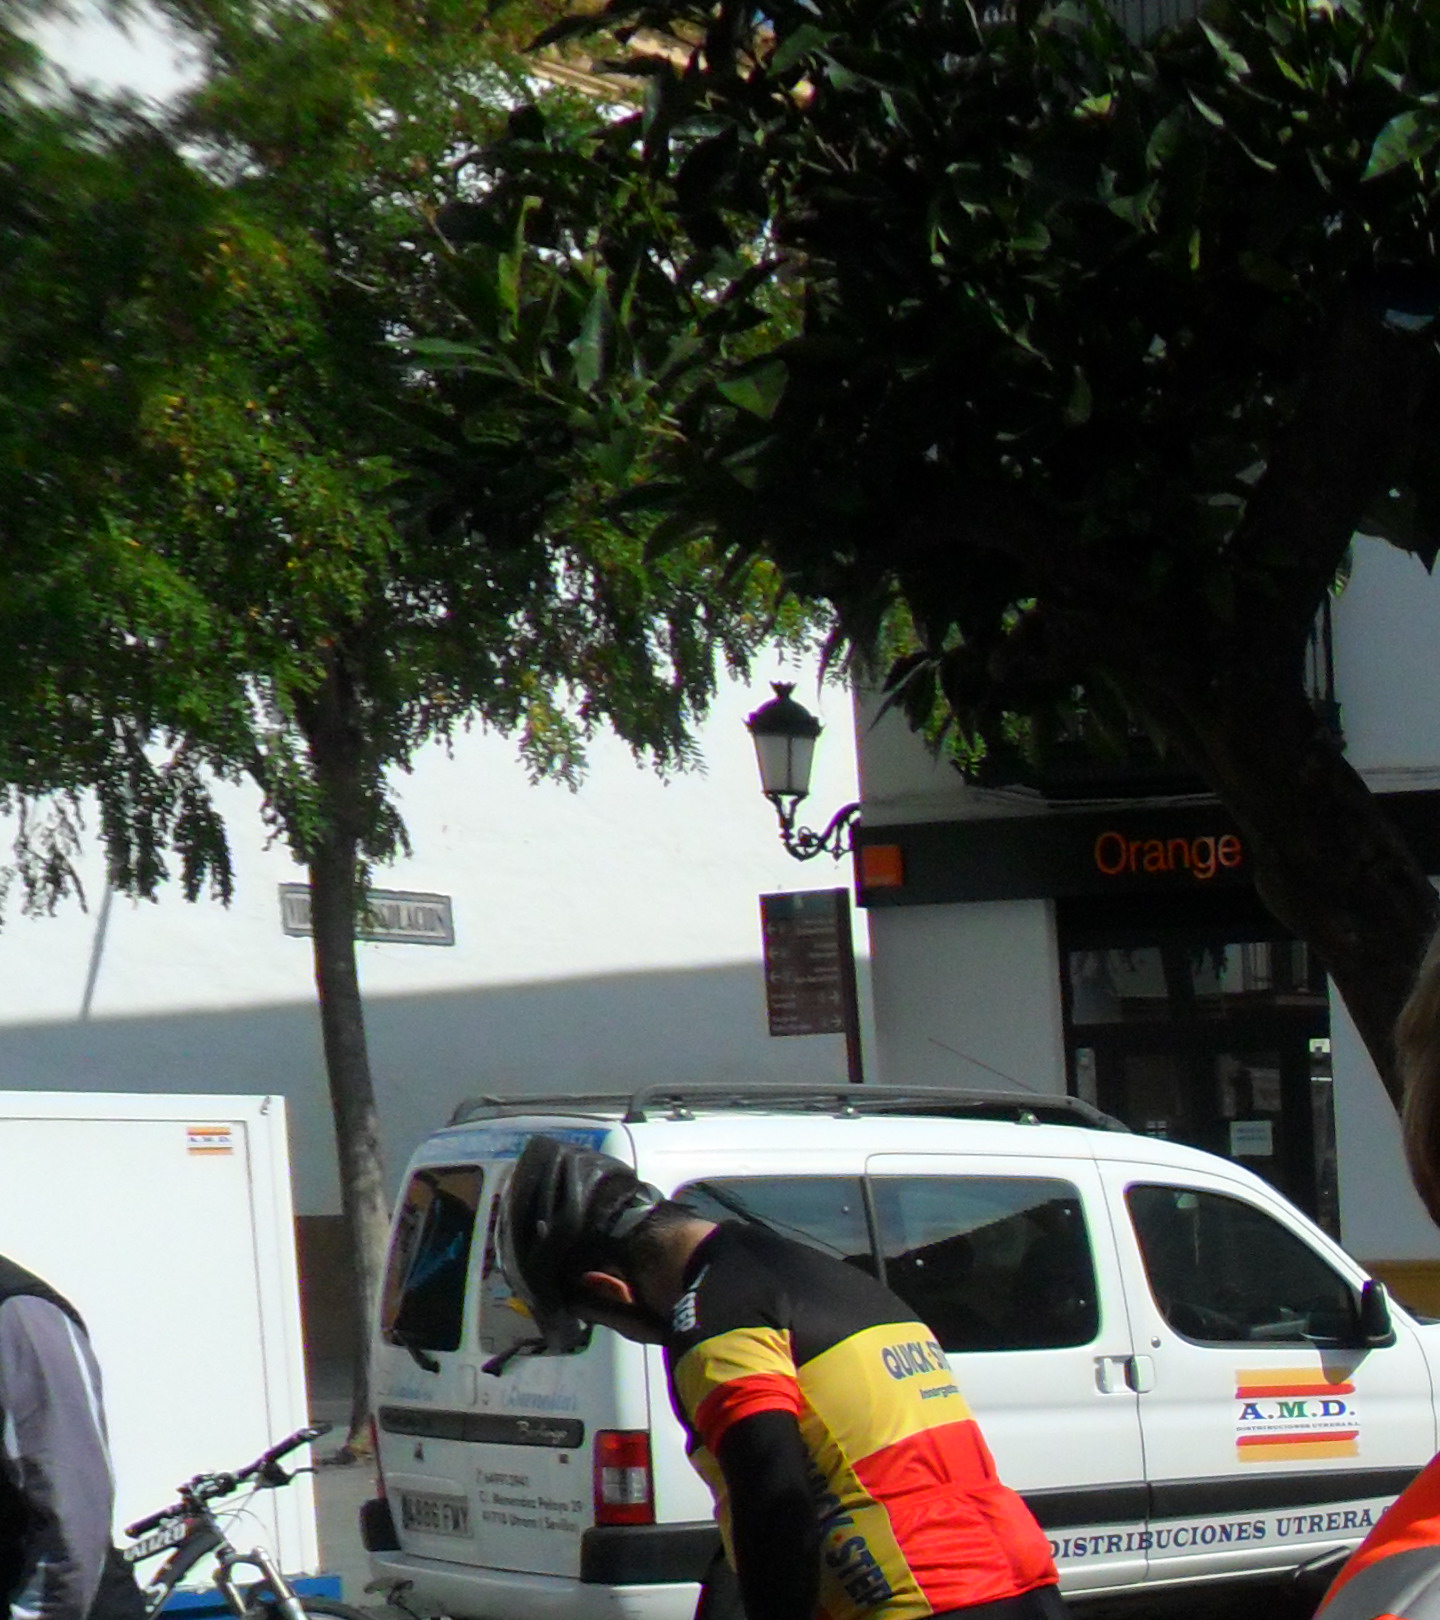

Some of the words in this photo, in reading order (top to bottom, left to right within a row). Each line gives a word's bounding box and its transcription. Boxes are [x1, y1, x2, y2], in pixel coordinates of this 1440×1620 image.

[1094, 831, 1242, 880] Orange
[1238, 1399, 1356, 1420] A.M.D.
[1276, 1508, 1375, 1538] UTRERA
